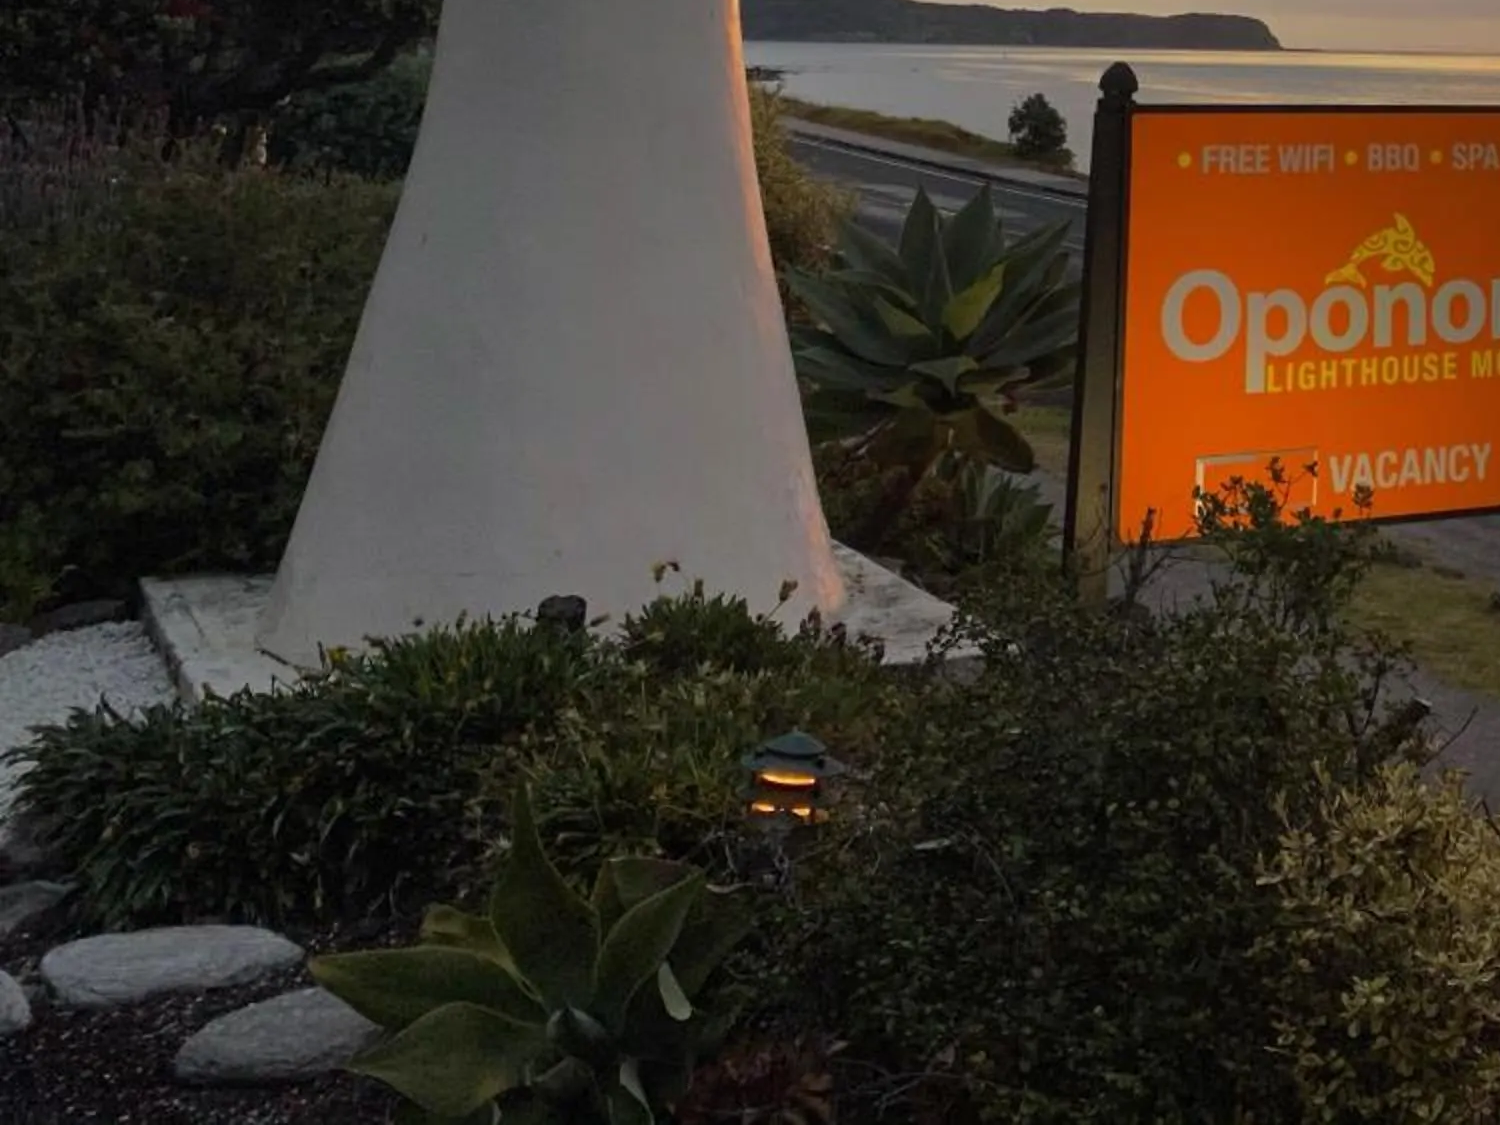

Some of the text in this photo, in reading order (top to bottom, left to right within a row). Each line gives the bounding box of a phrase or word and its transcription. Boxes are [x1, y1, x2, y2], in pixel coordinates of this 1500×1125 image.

[1202, 144, 1269, 174] FREE
[1279, 143, 1334, 173] WIFI
[1367, 143, 1420, 172] BBQ
[1451, 143, 1499, 170] SPA
[1266, 352, 1458, 393] LIGHTHOUSE
[1329, 443, 1491, 493] VACANCY
